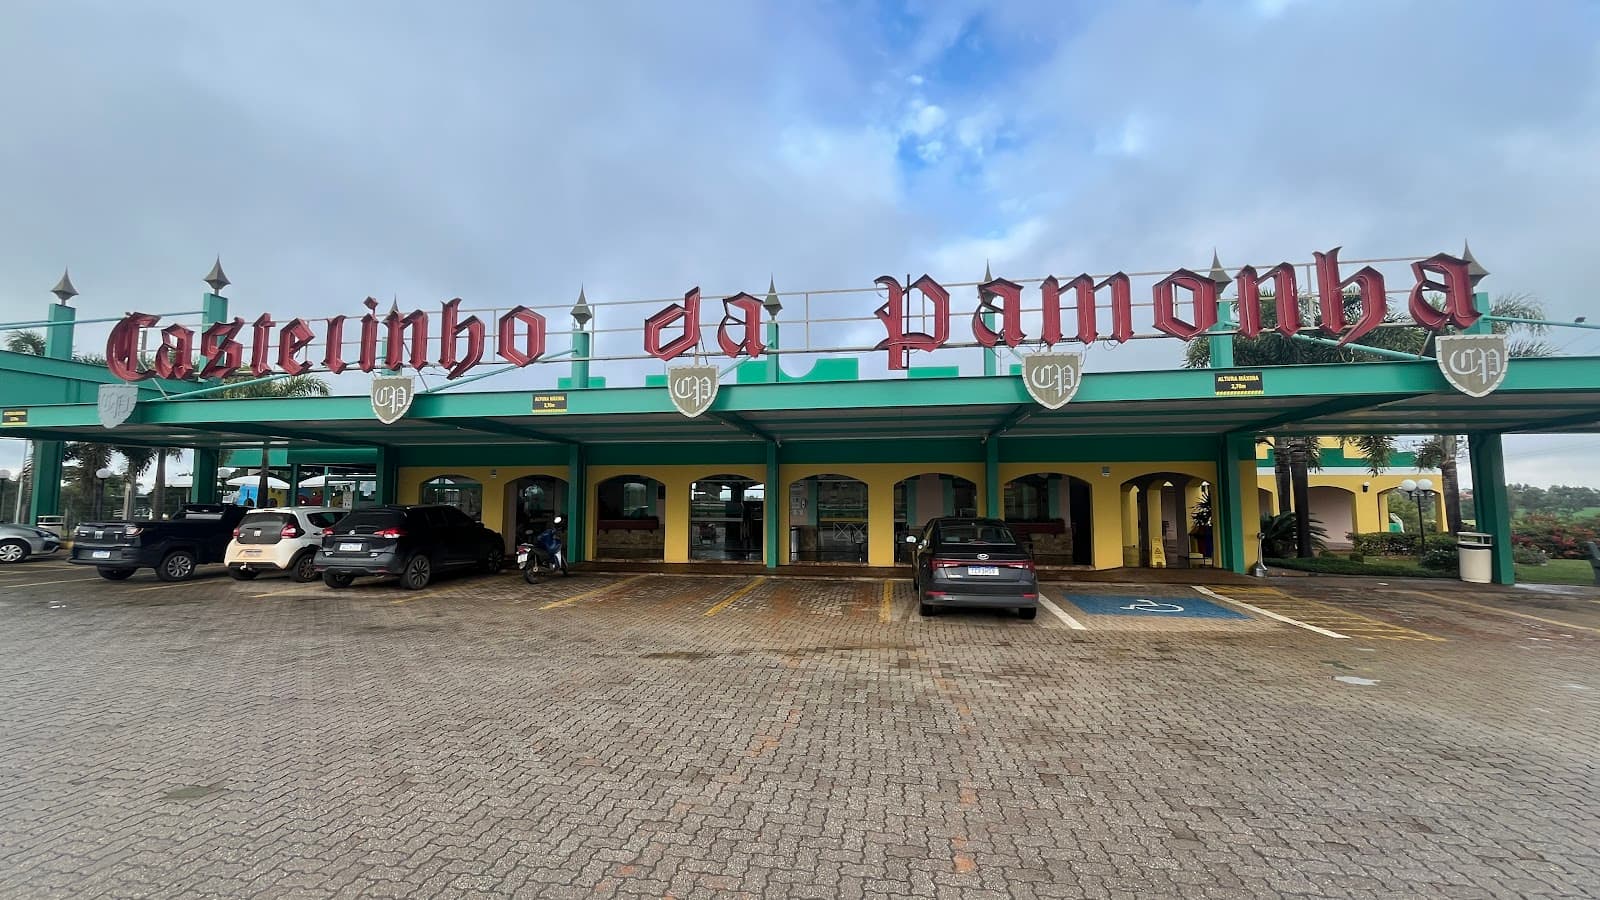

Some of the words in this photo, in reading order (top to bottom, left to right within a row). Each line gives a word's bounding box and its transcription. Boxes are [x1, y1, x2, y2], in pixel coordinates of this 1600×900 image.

[106, 296, 546, 381] Castelinho
[644, 286, 766, 361] da
[873, 246, 1482, 370] Pamonha
[1032, 363, 1075, 397] CP
[1449, 347, 1500, 384] CP
[375, 385, 406, 414] CP
[675, 375, 711, 408] CP
